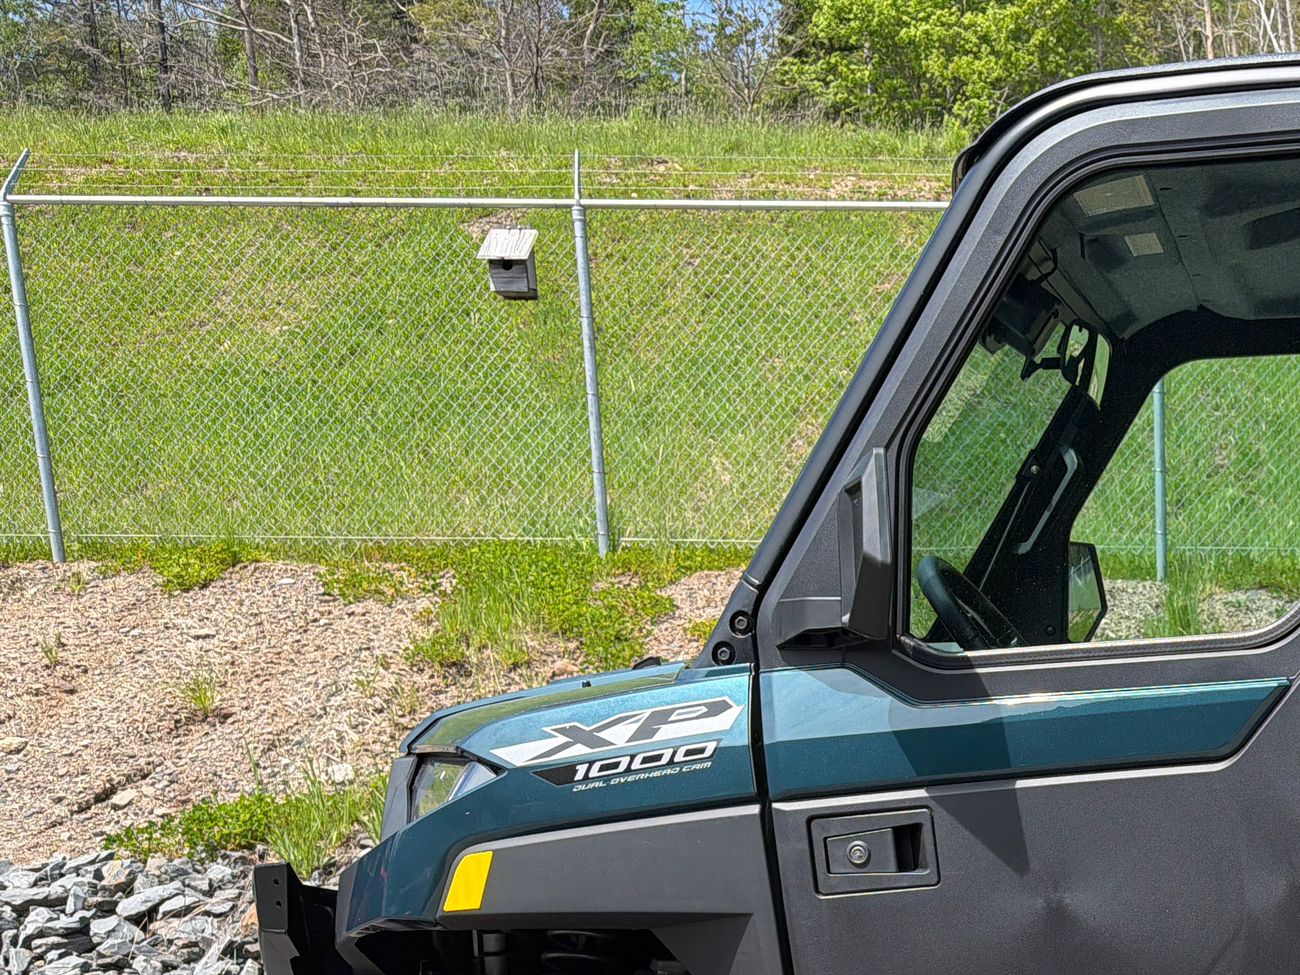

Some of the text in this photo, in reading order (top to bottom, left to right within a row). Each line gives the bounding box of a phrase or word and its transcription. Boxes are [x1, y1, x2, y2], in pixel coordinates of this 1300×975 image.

[524, 697, 735, 762] XP
[572, 761, 713, 792] DUAL OVERHEAD CAM
[573, 740, 718, 781] 1000
